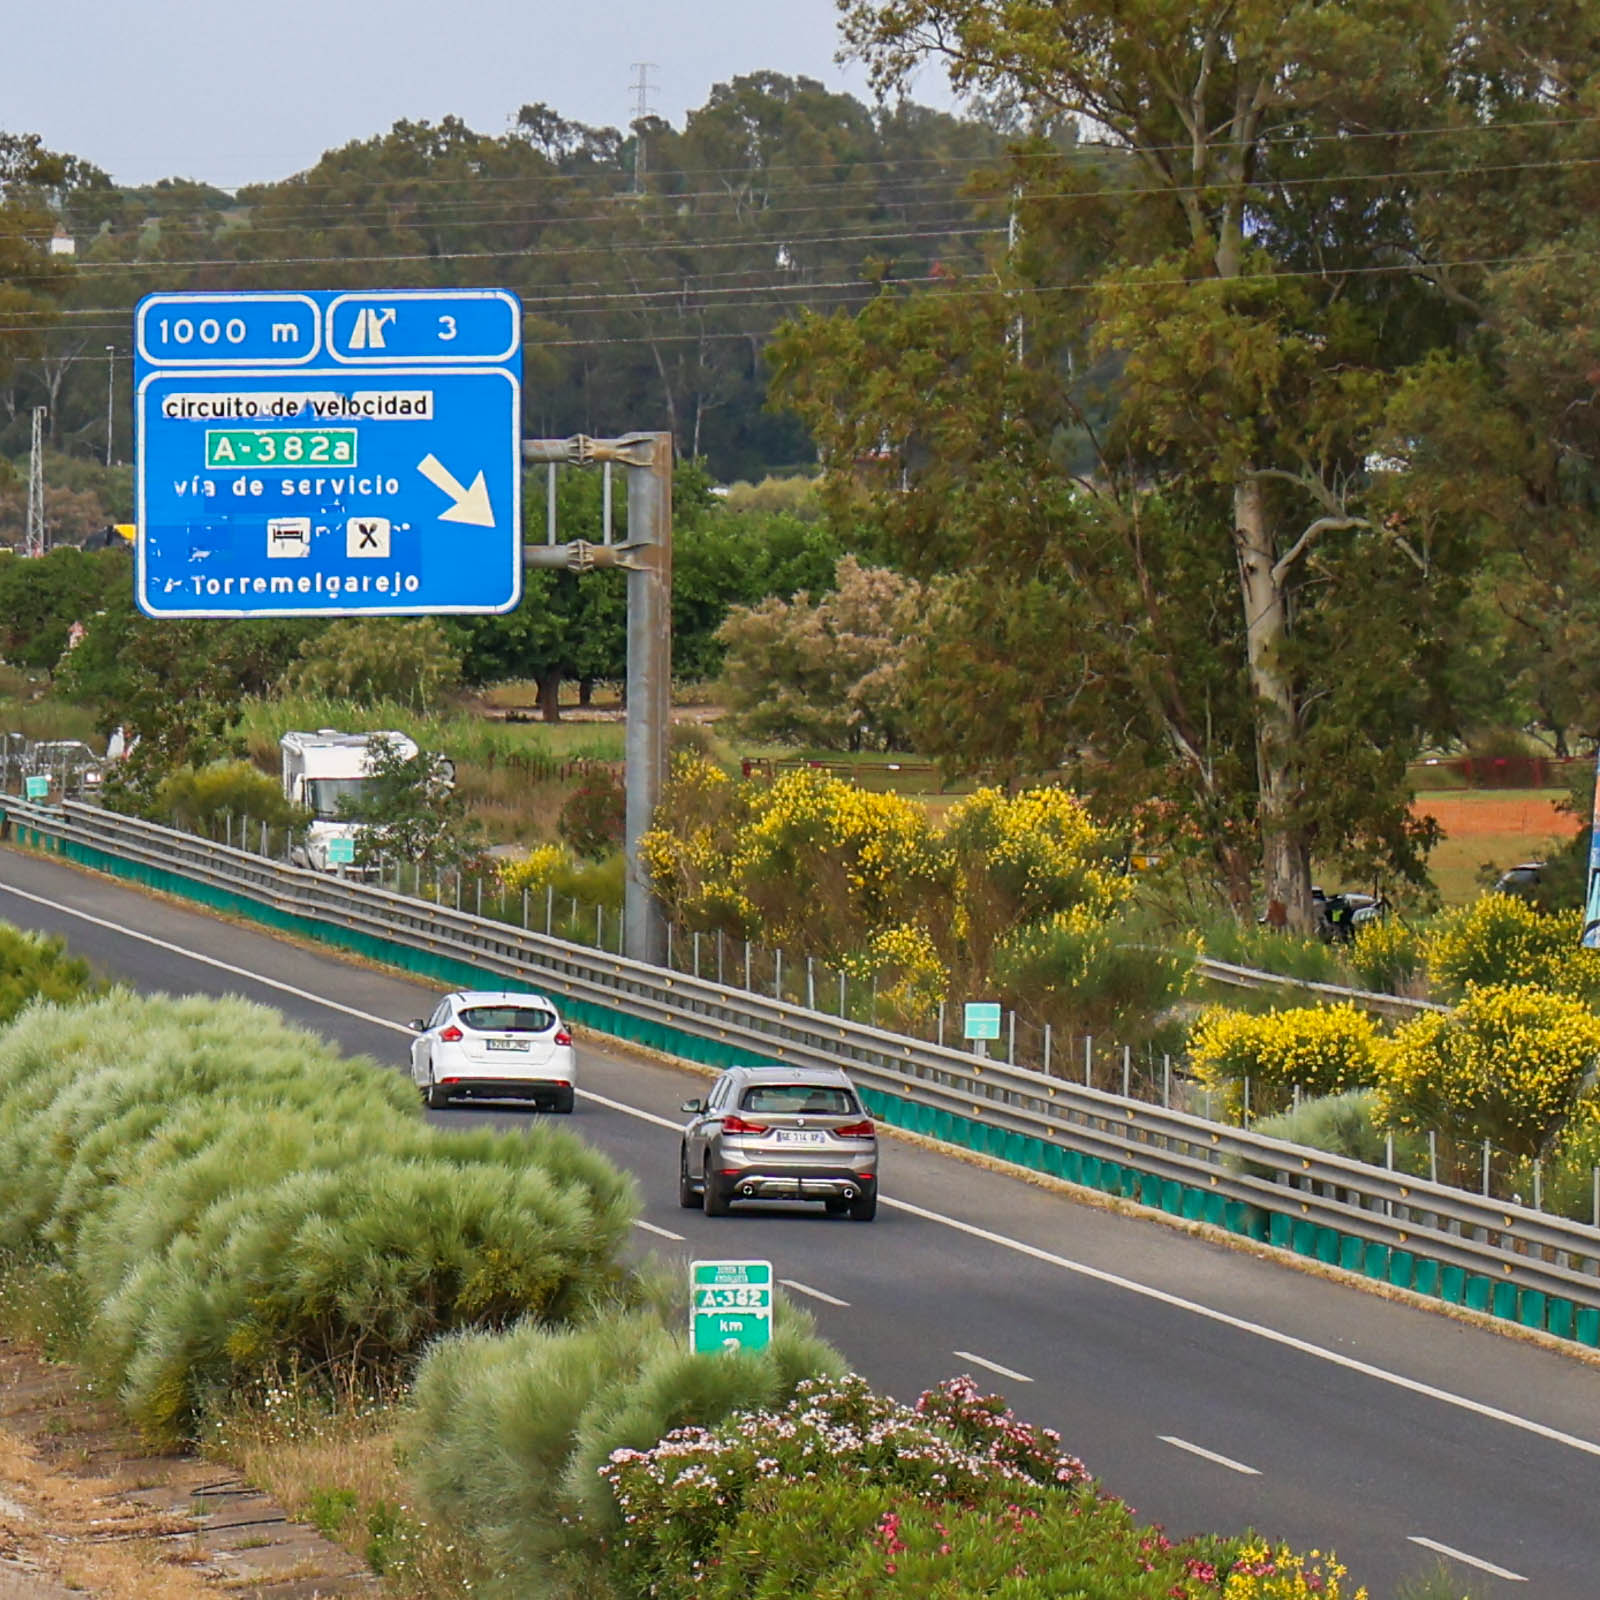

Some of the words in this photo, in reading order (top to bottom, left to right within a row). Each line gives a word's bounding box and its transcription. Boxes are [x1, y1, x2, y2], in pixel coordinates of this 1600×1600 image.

[160, 318, 246, 344] 1000
[271, 322, 299, 343] m
[437, 315, 458, 341] 3
[166, 398, 258, 417] circuito
[271, 397, 299, 416] de
[313, 395, 427, 416] velocidad
[213, 436, 351, 462] A-382a
[174, 475, 216, 497] vía
[232, 475, 264, 496] de
[281, 474, 400, 496] servicio
[191, 571, 420, 599] Torremelgarejo
[701, 1289, 763, 1307] A-382
[720, 1319, 744, 1332] km
